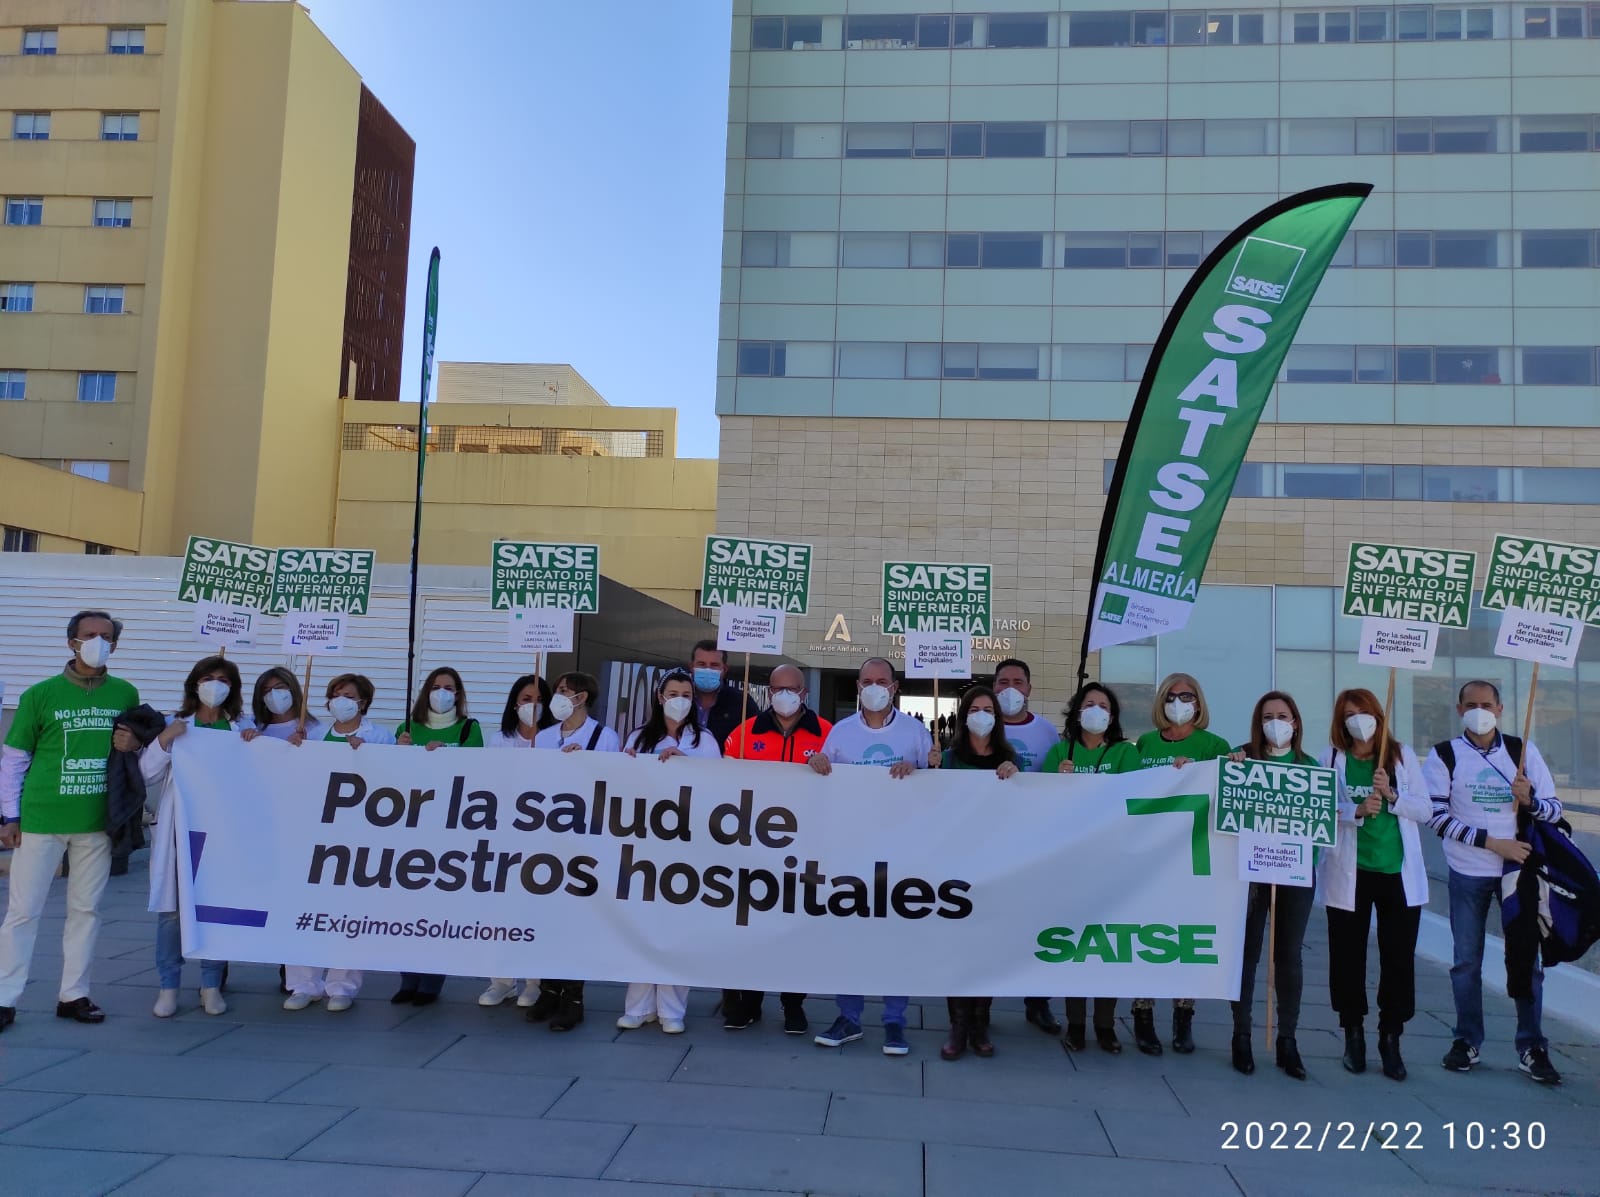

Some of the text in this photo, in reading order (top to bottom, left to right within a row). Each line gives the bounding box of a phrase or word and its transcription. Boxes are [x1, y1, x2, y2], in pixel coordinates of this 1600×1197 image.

[1231, 276, 1285, 299] SATSE
[1135, 304, 1273, 568] SATSE
[280, 551, 371, 574] SATSE
[496, 544, 595, 569] SATSE
[709, 540, 808, 570] SATSE
[1353, 545, 1471, 580] SATSE
[186, 573, 271, 595] ENFERMERI
[188, 562, 273, 585] SINDICATO D
[278, 574, 367, 585] SINDICATO DE
[496, 569, 593, 581] SINDICATO DE
[708, 564, 805, 582] SINDICATO DE
[708, 575, 804, 593] ENFERMERIA
[888, 565, 987, 591] SATSE
[1103, 561, 1197, 600] ALMERÍA
[1352, 571, 1467, 593] SINDICATO DE
[1494, 564, 1585, 587] SINDICATO
[276, 584, 365, 595] ENFERMERIA
[496, 580, 593, 591] ENFERMERIA
[888, 590, 986, 603] SINDICATO DE
[1351, 583, 1465, 605] ENFERMERIA
[1492, 576, 1600, 602] ENFERMERI
[273, 595, 363, 614] ALMERÍA
[495, 591, 593, 610] ALMERÍA
[706, 588, 803, 612] ALMERÍA
[887, 602, 986, 614] ENFERMERIA
[1348, 596, 1463, 626] ALMERÍA
[887, 613, 986, 635] ALMERÍA
[1517, 622, 1532, 630] Por
[1541, 627, 1564, 636] salud
[1375, 643, 1415, 653] hospitales
[1387, 639, 1422, 648] nuestros
[1399, 633, 1421, 641] salud
[1514, 634, 1556, 648] hospitales
[1528, 631, 1564, 643] nuestros
[54, 710, 71, 720] NO
[78, 708, 91, 717] LOS
[63, 721, 72, 729] EN
[65, 758, 107, 770] SATSE
[60, 775, 75, 784] POR
[1223, 760, 1332, 796] SATSE
[60, 784, 108, 795] DERECHOS
[1222, 786, 1331, 809] SINDICATO DE
[321, 771, 798, 849] Por la salud de
[1222, 798, 1331, 821] ENFERMERIA
[1221, 811, 1331, 843] ALMERÍA
[1253, 859, 1292, 868] hospitales
[1265, 854, 1298, 862] nuestros
[307, 839, 974, 927] nuestros hospitales
[295, 912, 536, 942] #ExigimosSoluciones
[1034, 923, 1219, 965] SATSE
